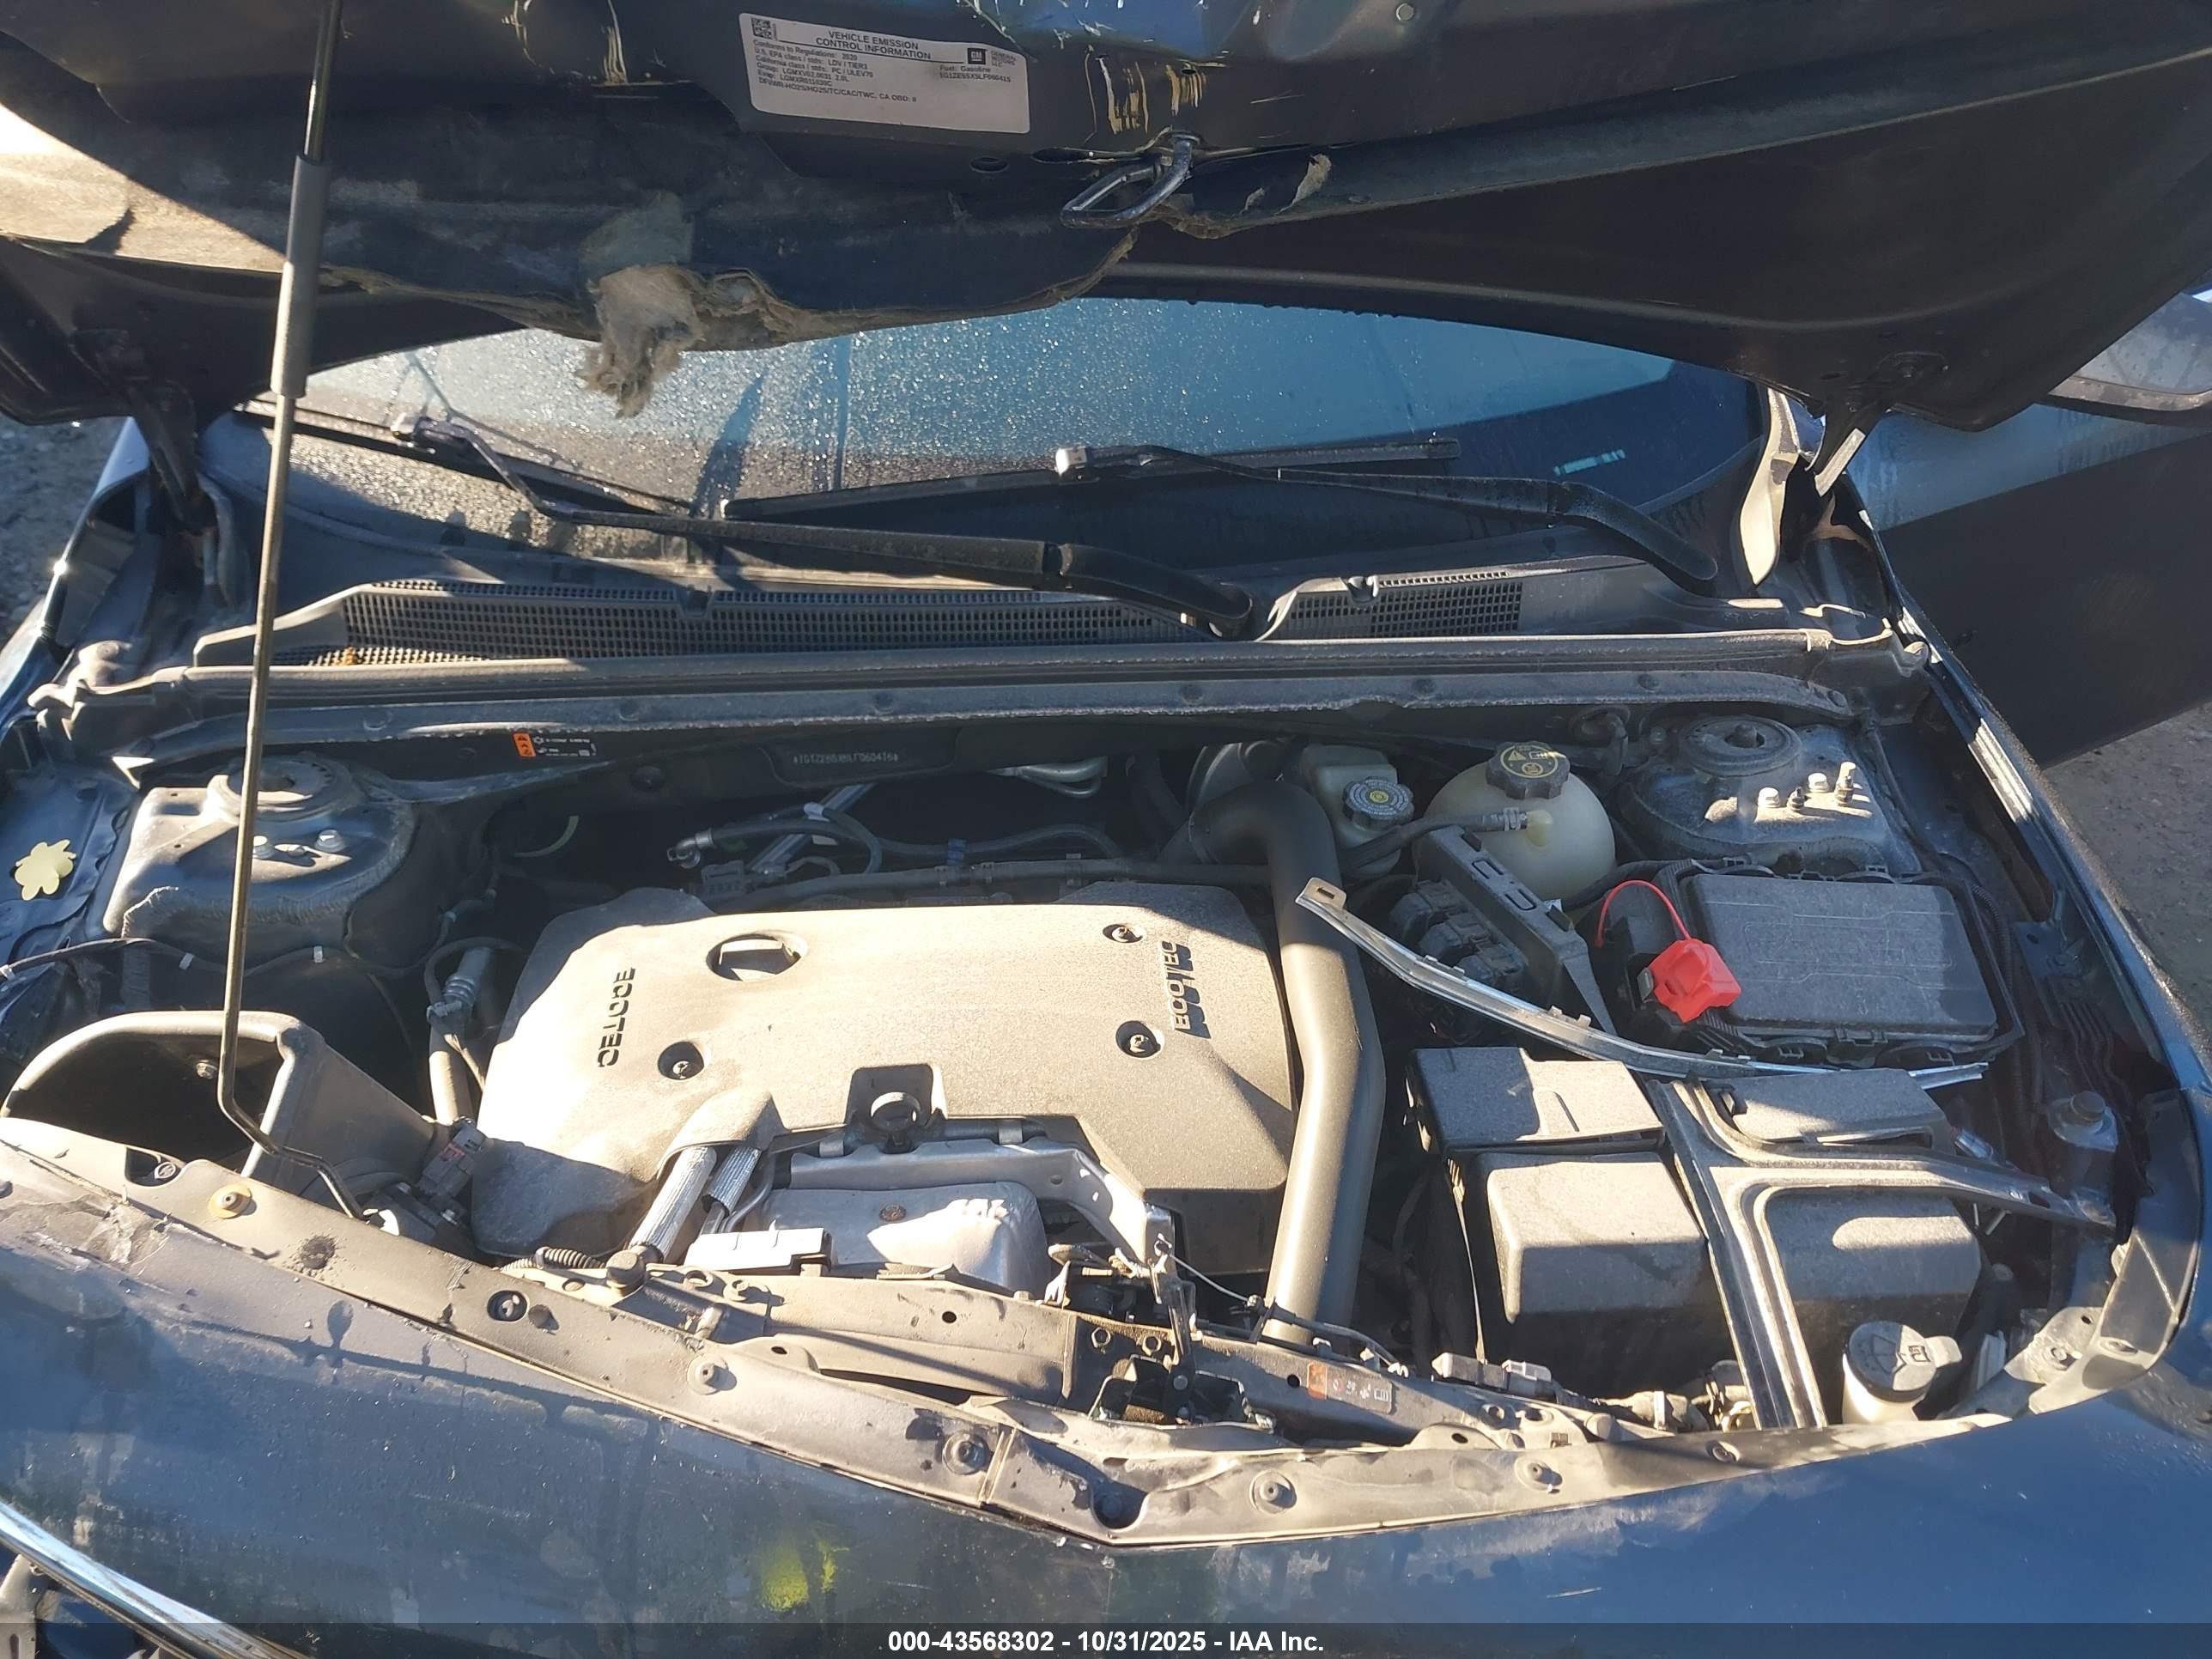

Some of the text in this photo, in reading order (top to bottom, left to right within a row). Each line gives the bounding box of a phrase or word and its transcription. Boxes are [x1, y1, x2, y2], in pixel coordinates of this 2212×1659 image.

[817, 37, 931, 59] CONTROL INFORMATION
[829, 30, 919, 50] VEHICLE EMISSION
[1159, 939, 1202, 1034] ECOTEC
